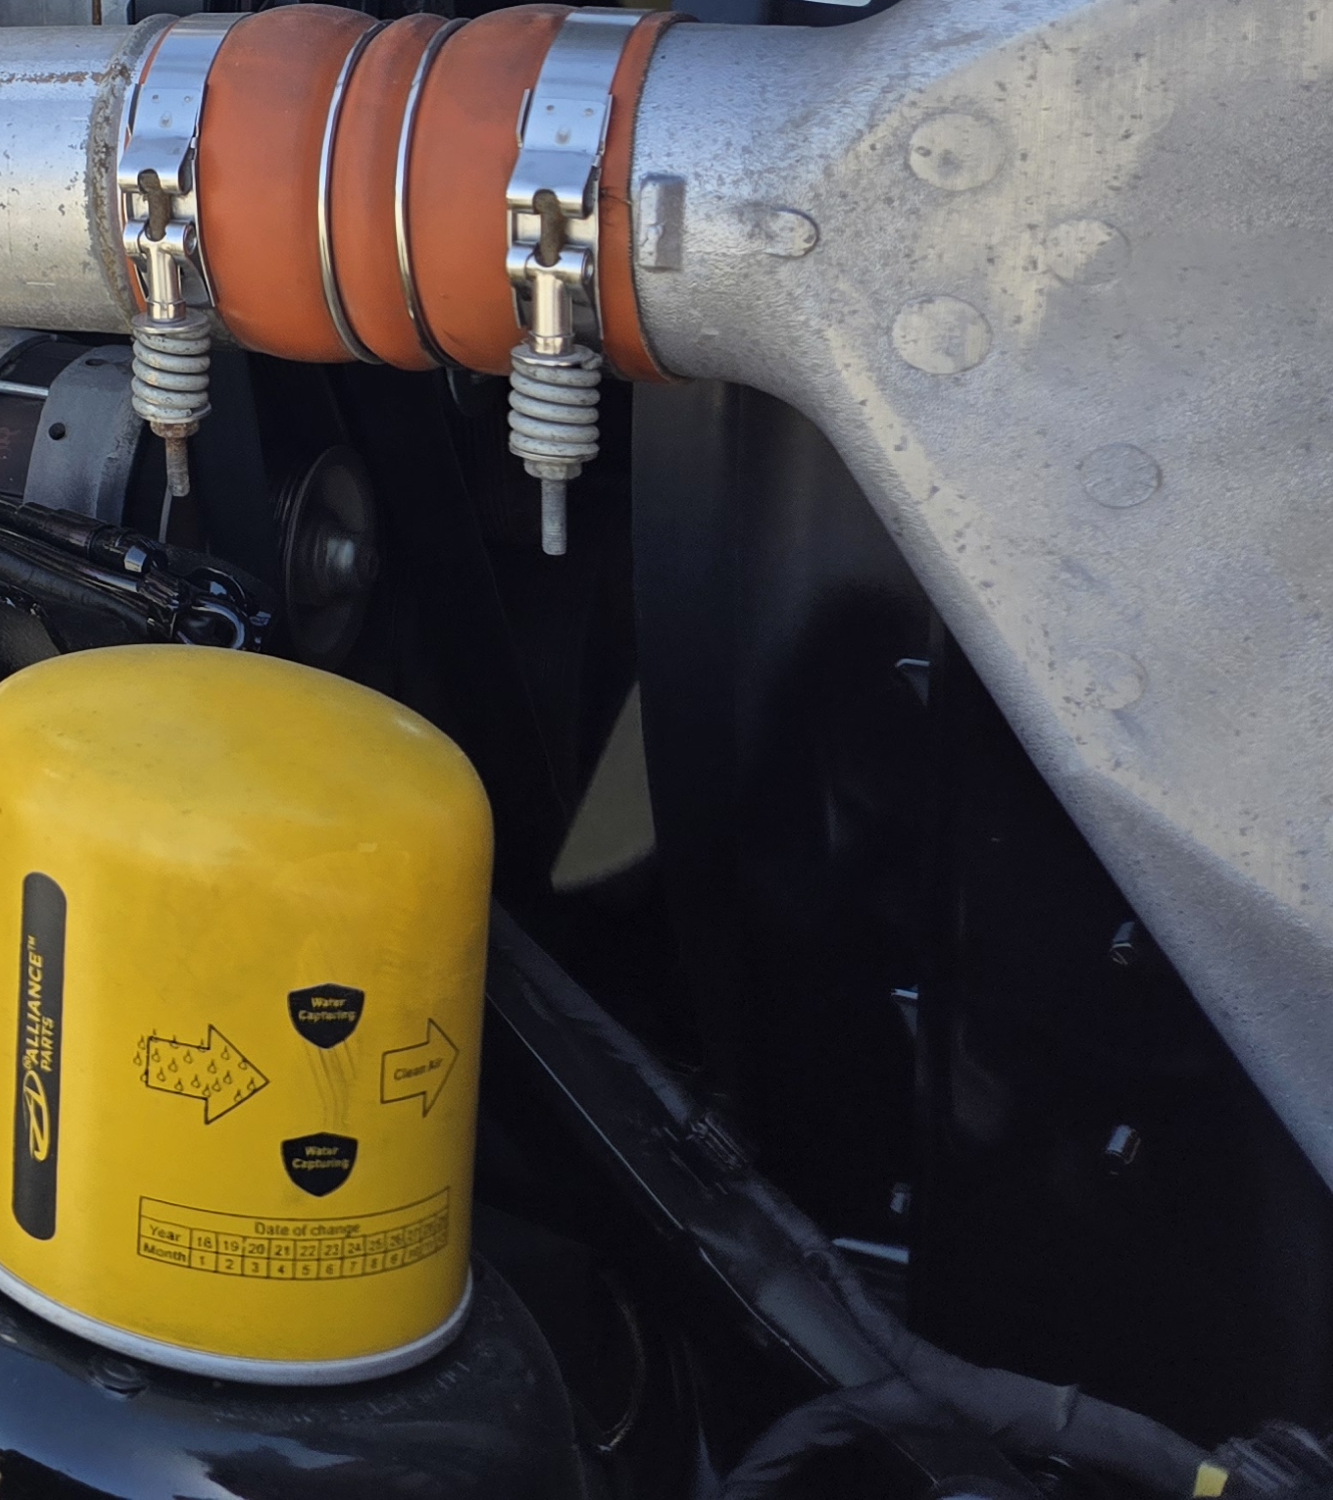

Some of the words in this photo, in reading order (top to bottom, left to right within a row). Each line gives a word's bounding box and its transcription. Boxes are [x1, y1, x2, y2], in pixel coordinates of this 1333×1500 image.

[311, 997, 346, 1008] Water
[298, 1008, 356, 1022] Capturing
[40, 1016, 54, 1071] PARTS
[393, 1065, 426, 1081] Clean
[305, 1146, 339, 1156] Water
[292, 1158, 350, 1171] Capturing
[254, 1222, 289, 1236] Date
[292, 1222, 307, 1236] of
[310, 1222, 360, 1238] change
[149, 1223, 181, 1243] Year
[223, 1240, 239, 1252] 19
[248, 1242, 266, 1255] 20
[274, 1244, 291, 1257] 21
[299, 1244, 317, 1257] 22
[324, 1243, 342, 1257] 23
[346, 1241, 362, 1255] 24
[143, 1242, 186, 1263] Month
[199, 1255, 206, 1266] 1
[225, 1259, 234, 1269] 2
[251, 1262, 260, 1274] 3
[277, 1263, 286, 1275] 4
[302, 1263, 310, 1275] 5
[326, 1263, 334, 1275] 6
[350, 1261, 358, 1273] 7
